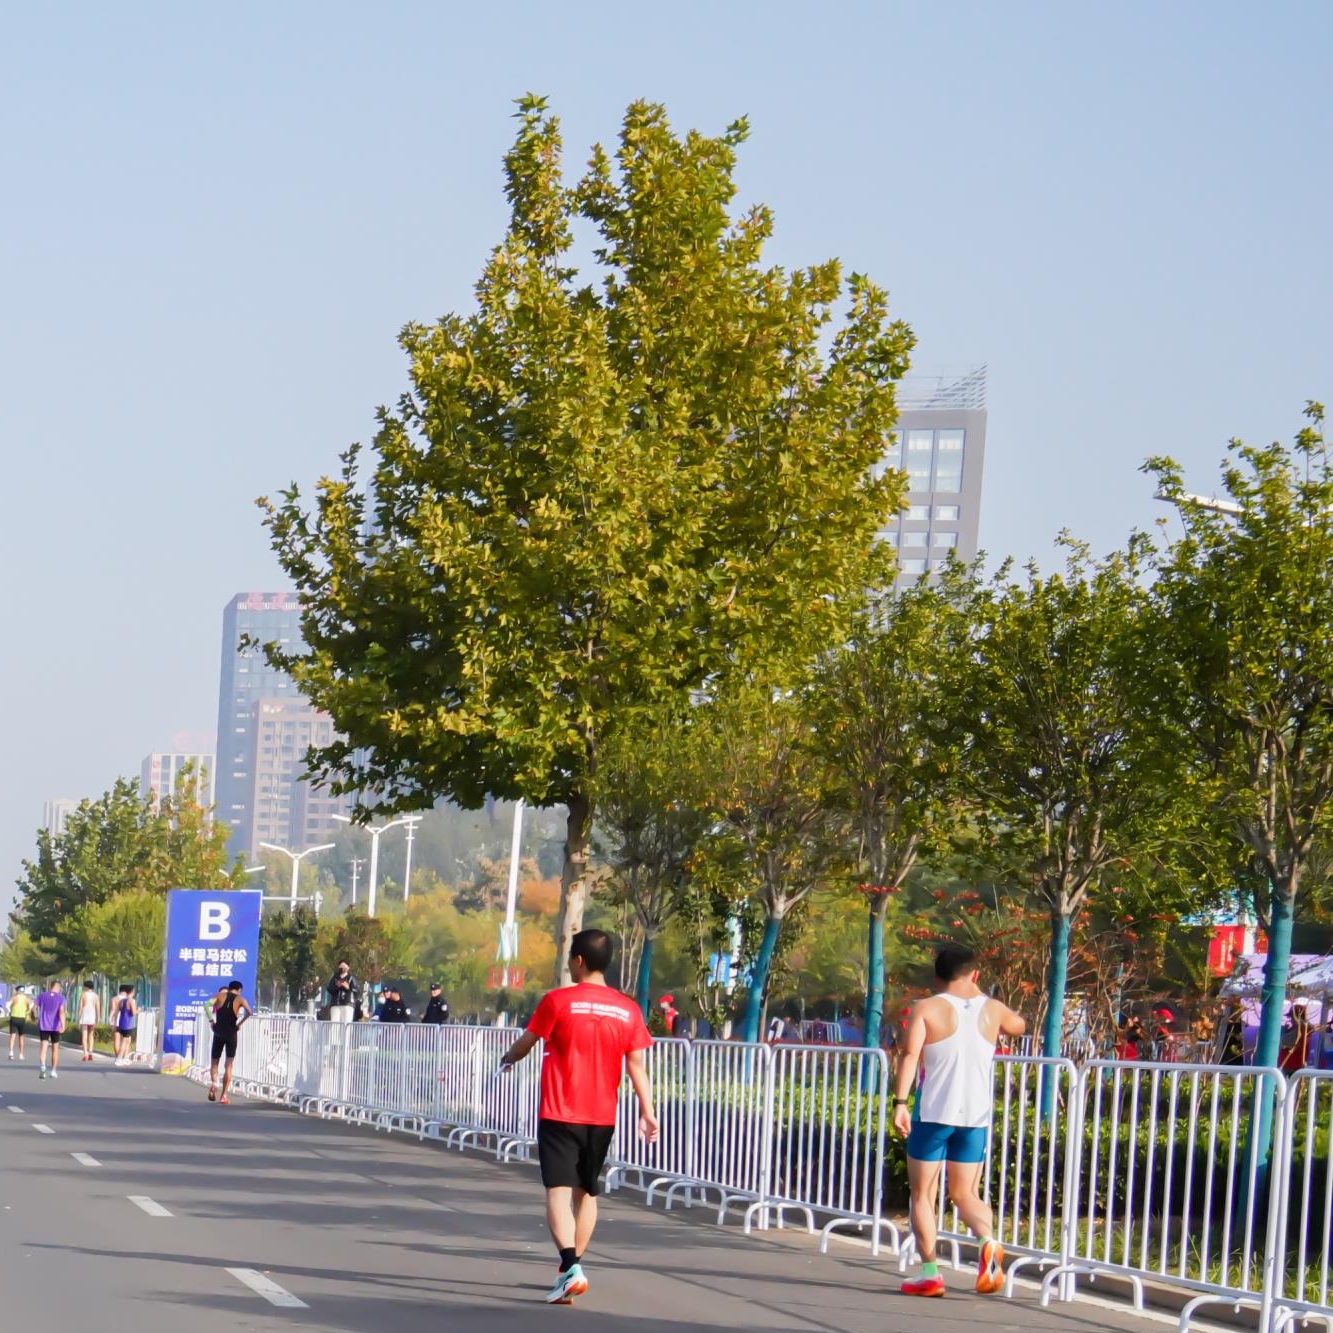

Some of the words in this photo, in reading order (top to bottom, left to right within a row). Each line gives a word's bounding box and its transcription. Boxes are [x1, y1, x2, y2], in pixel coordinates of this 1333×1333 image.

[199, 902, 231, 940] B
[179, 947, 247, 963] 半程马拉松
[191, 963, 233, 977] 集结区
